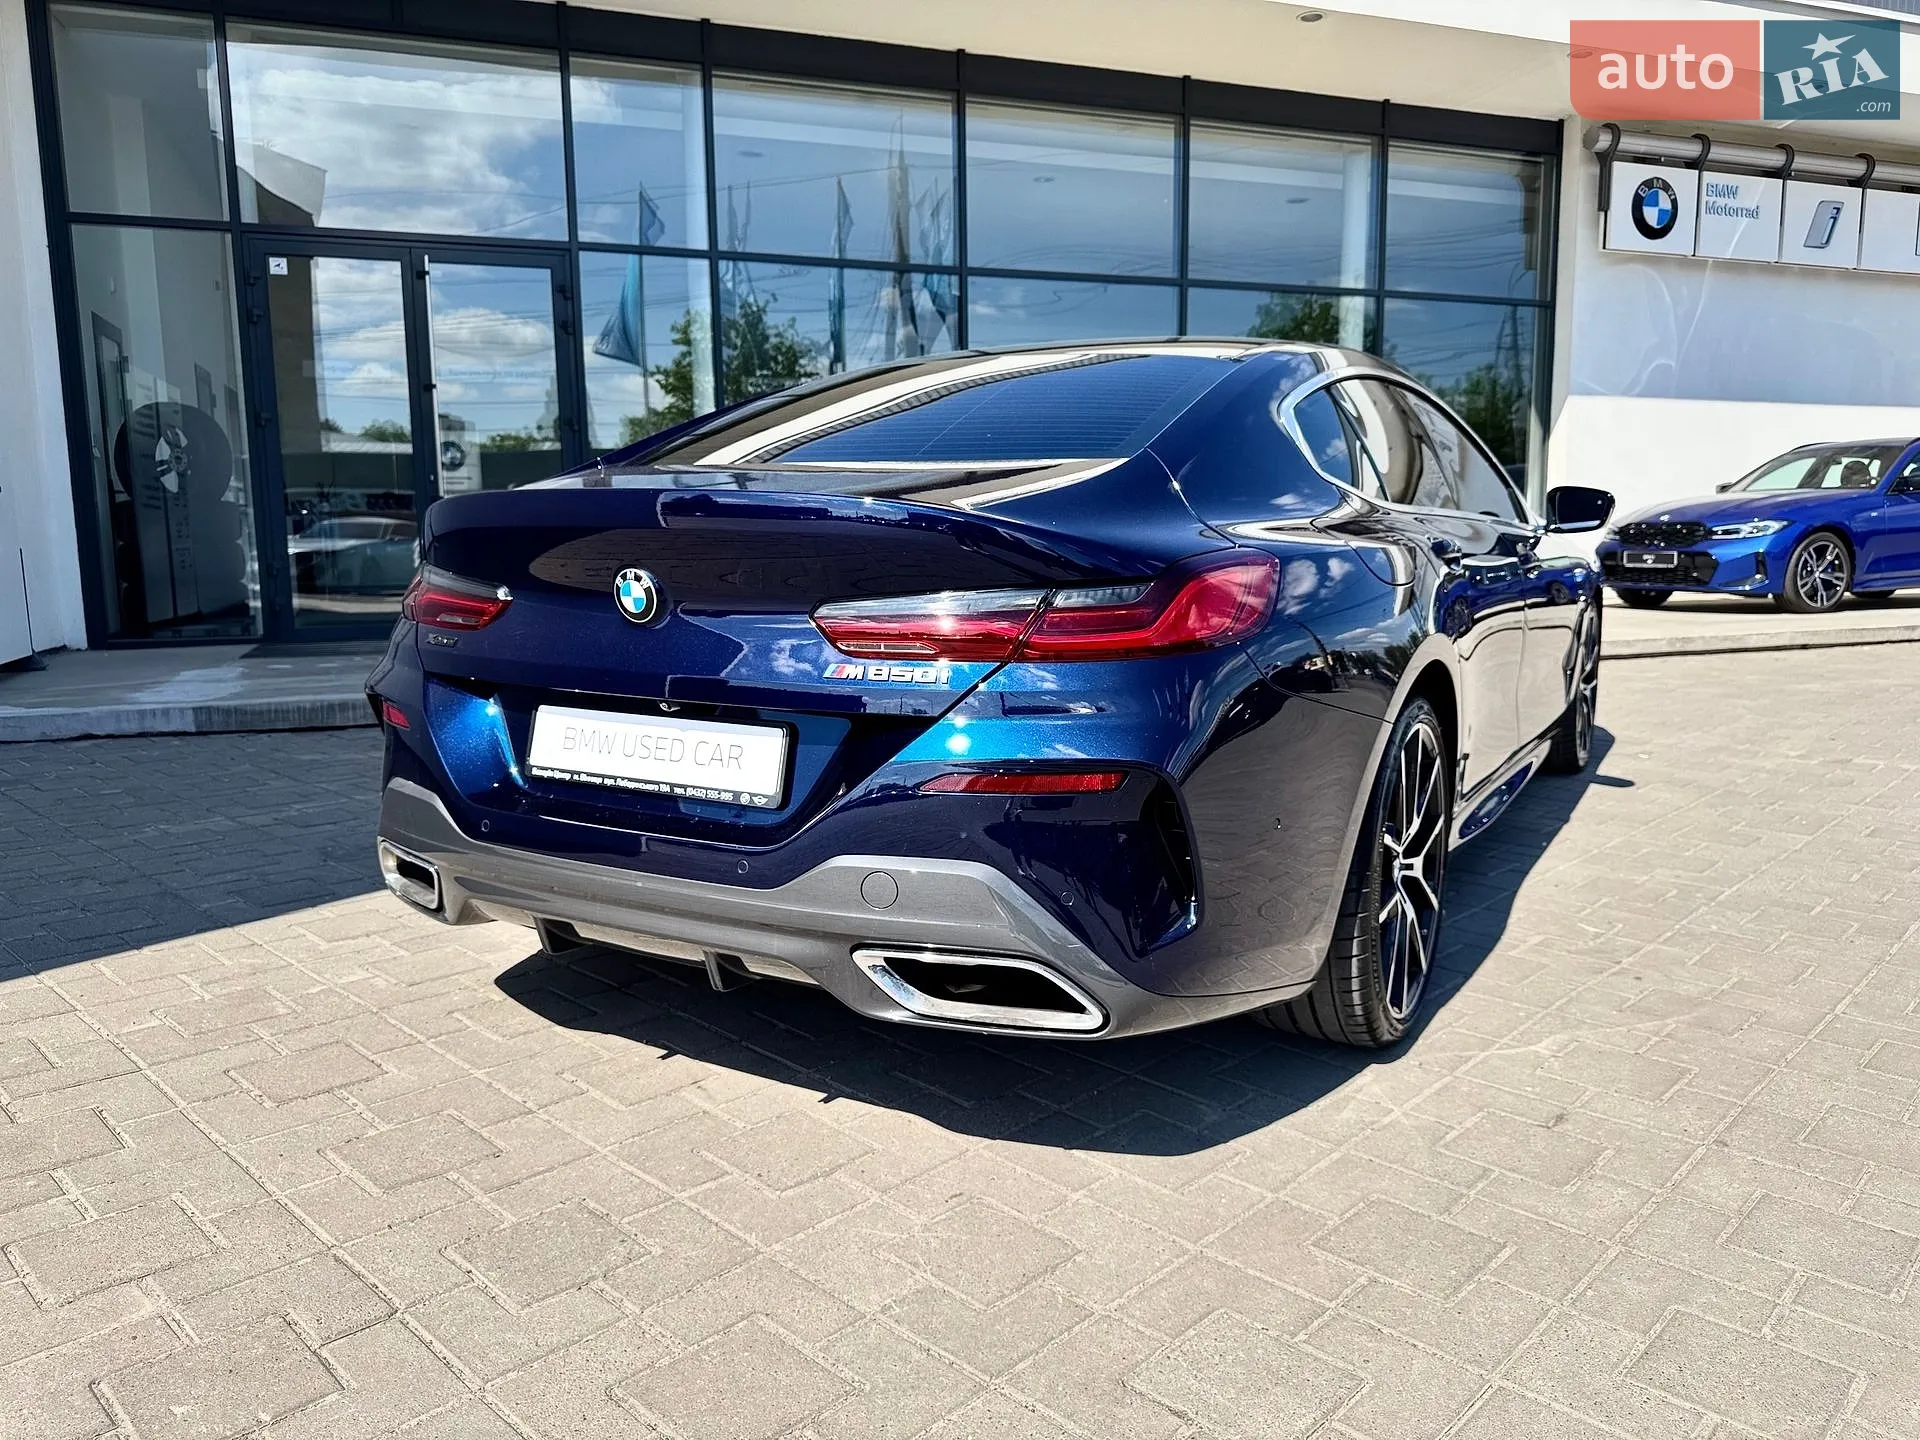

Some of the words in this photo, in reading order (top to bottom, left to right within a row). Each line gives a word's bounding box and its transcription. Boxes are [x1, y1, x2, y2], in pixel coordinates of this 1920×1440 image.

[1705, 183, 1740, 200] BMW
[1704, 200, 1761, 220] Motorrad
[563, 726, 617, 755] BMW
[622, 732, 685, 763] USED
[693, 740, 744, 770] CAR
